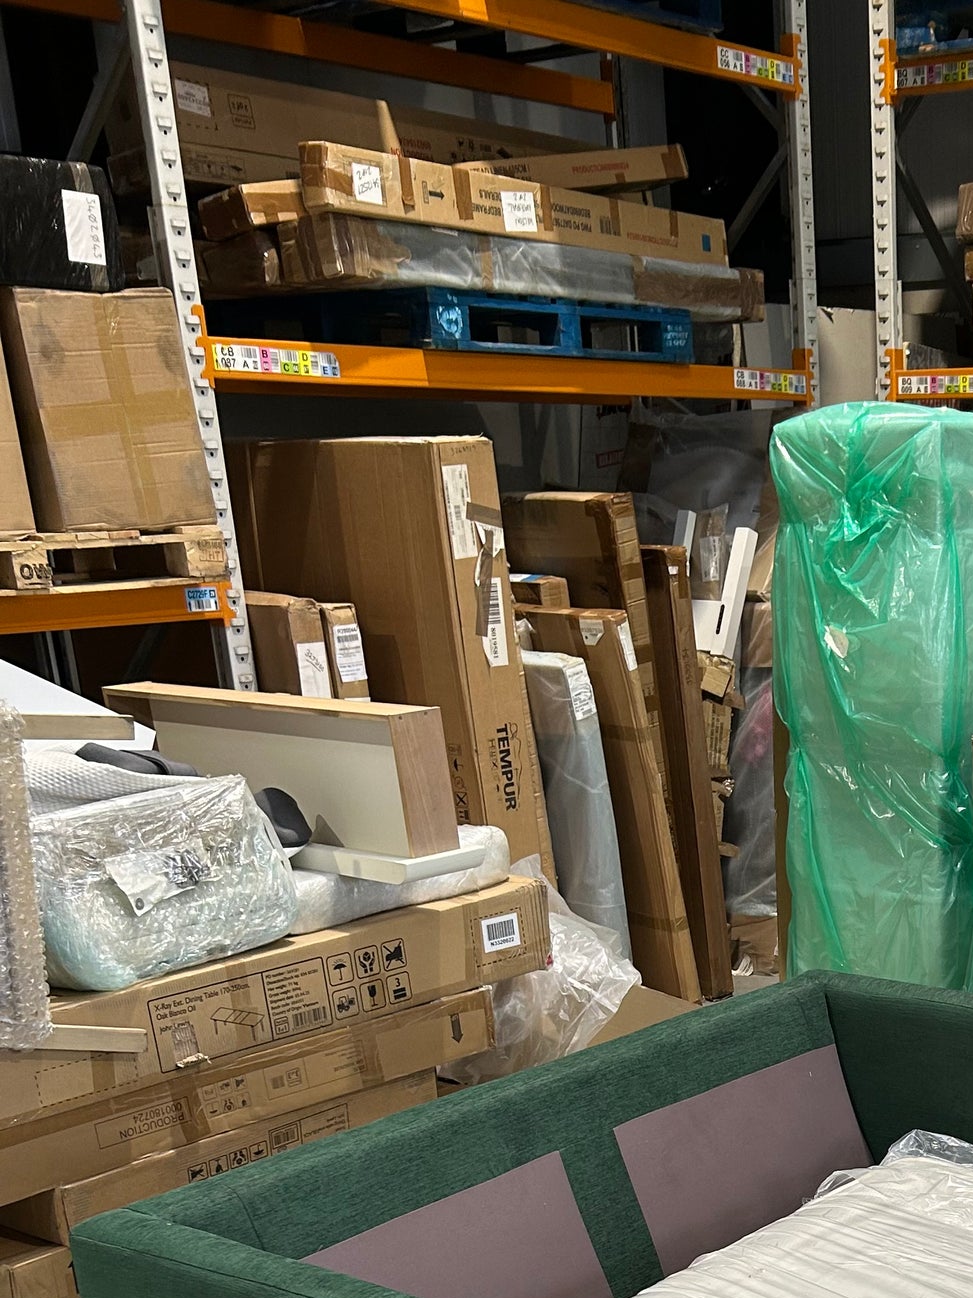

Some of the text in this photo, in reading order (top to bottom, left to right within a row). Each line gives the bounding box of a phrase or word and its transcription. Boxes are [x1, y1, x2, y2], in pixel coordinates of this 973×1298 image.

[221, 347, 308, 361] CB B D
[242, 361, 249, 369] A
[283, 363, 290, 372] C
[323, 366, 328, 375] E
[496, 723, 516, 811] TEMPUR
[395, 977, 400, 987] 3
[154, 1003, 172, 1012] X-Ray
[185, 995, 203, 1004] Dining
[203, 991, 218, 999] Table
[156, 1005, 196, 1020] Oak Bianco Oil
[132, 1102, 182, 1124] 000180724
[119, 1112, 185, 1139] PRODUCTION
